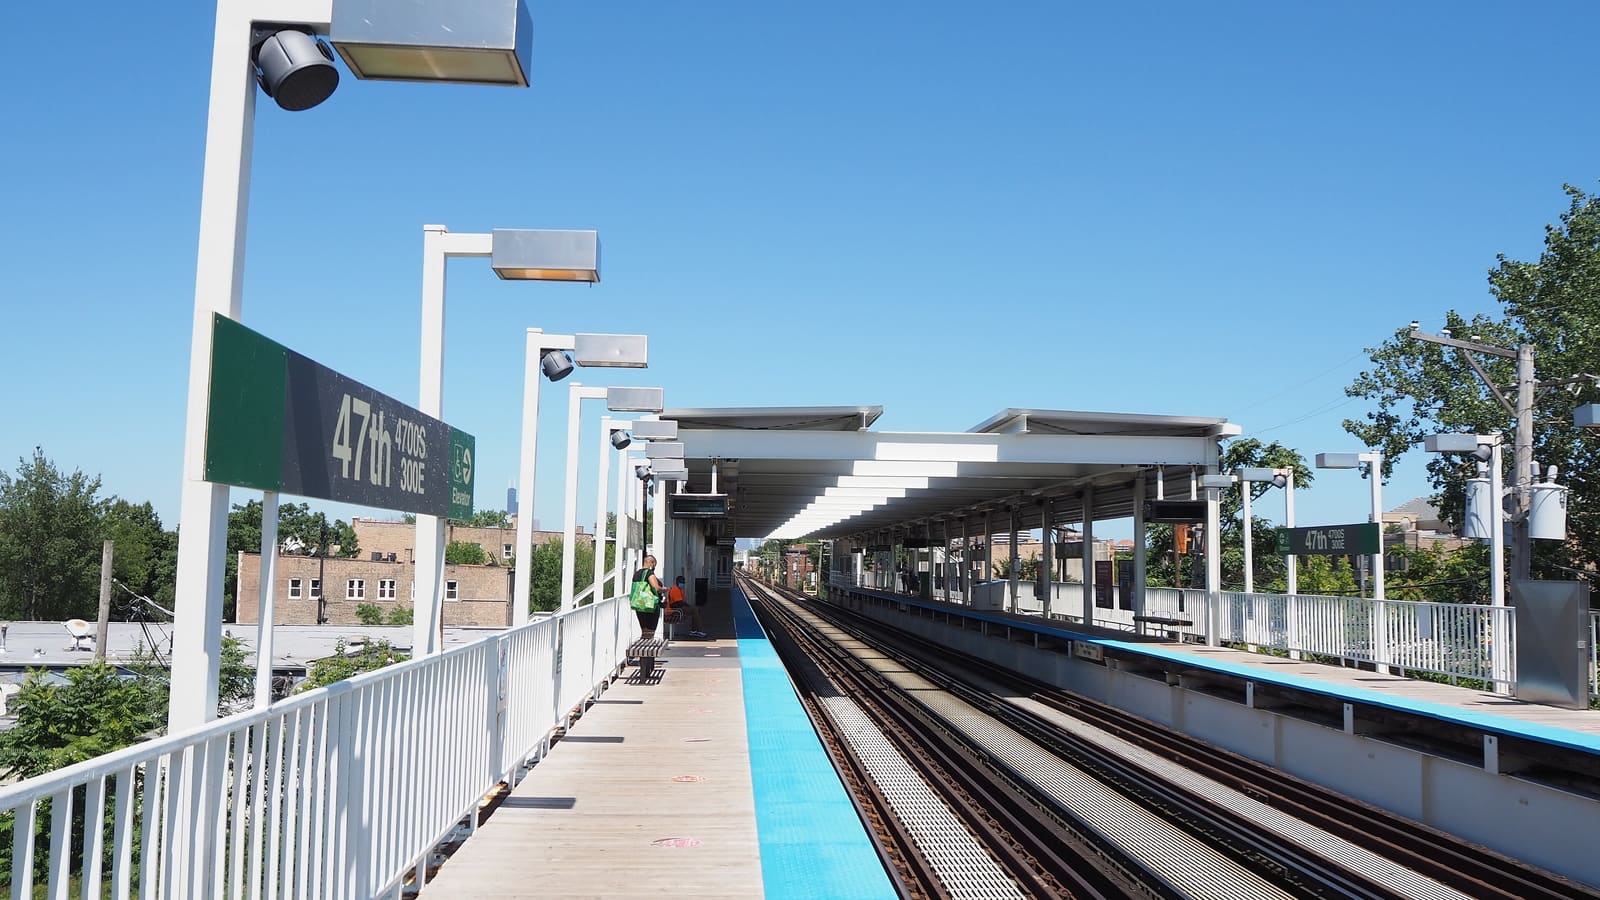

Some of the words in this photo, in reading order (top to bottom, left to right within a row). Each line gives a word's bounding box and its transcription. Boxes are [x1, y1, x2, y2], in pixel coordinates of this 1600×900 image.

[333, 393, 391, 487] 47th
[395, 418, 426, 459] 4700S
[400, 457, 425, 494] 300E
[453, 487, 470, 506] Elevator
[1305, 530, 1327, 549] 47th
